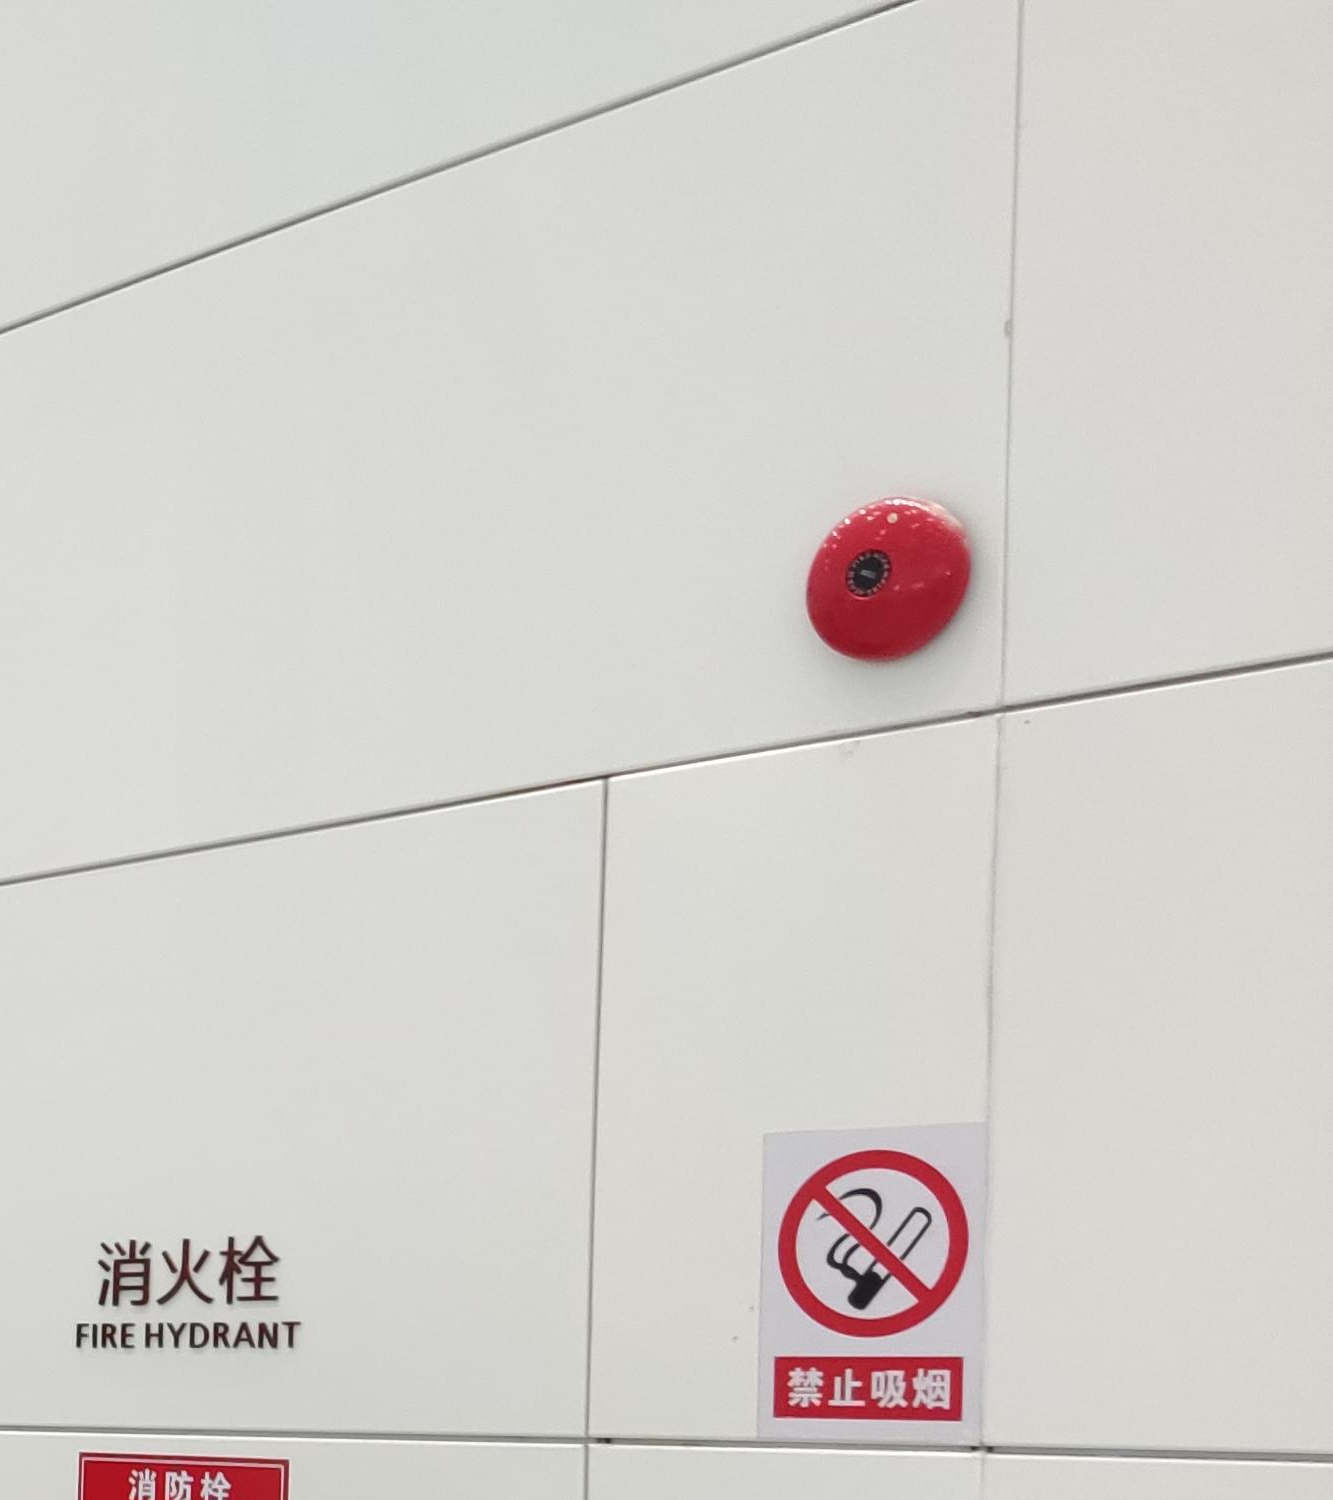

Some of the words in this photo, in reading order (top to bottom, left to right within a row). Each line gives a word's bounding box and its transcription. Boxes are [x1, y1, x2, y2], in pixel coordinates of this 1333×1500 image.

[98, 1235, 281, 1307] 消火栓
[76, 1322, 136, 1349] FIRE
[144, 1321, 302, 1349] HYDRANT
[787, 1367, 952, 1410] 禁止吸烟
